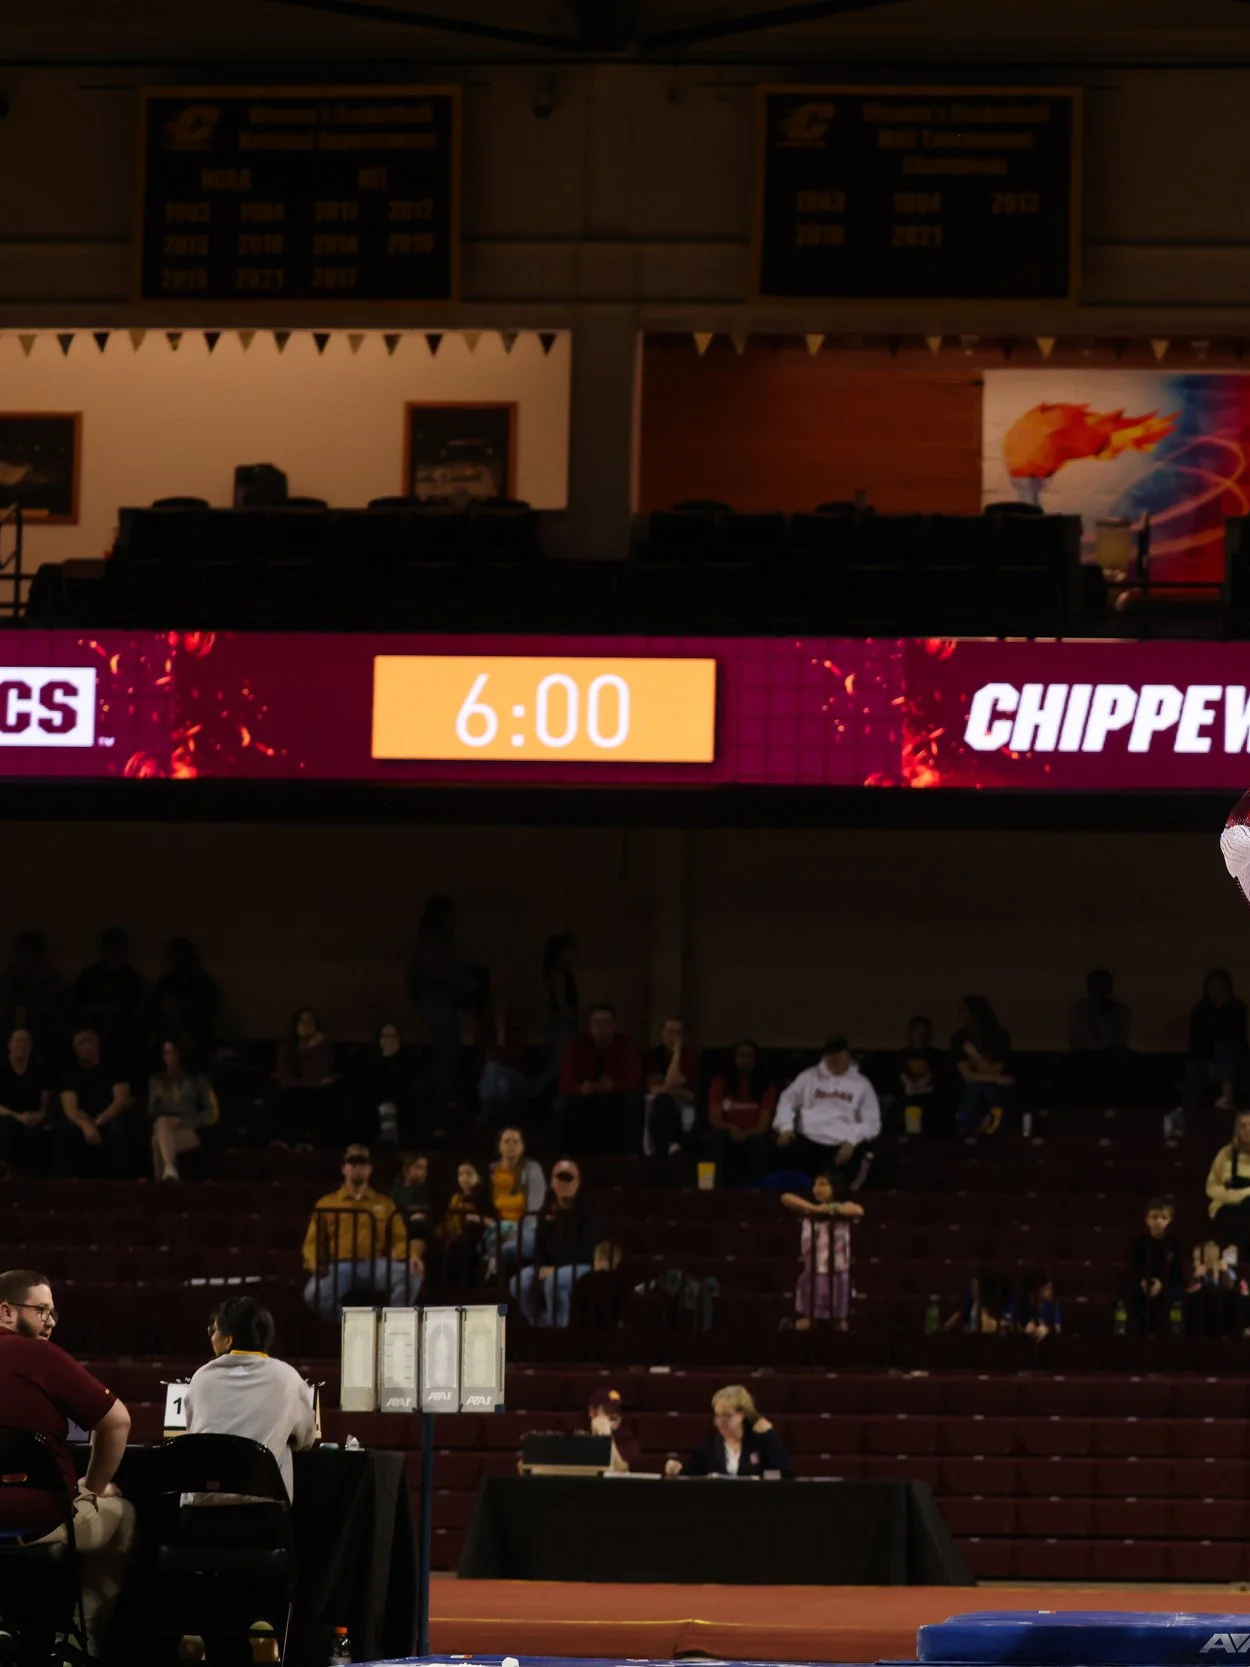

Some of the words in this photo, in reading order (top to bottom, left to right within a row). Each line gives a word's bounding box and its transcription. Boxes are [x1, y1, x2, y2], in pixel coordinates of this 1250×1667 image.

[890, 224, 943, 247] 2021
[0, 680, 79, 734] CS
[455, 673, 631, 749] 6:00
